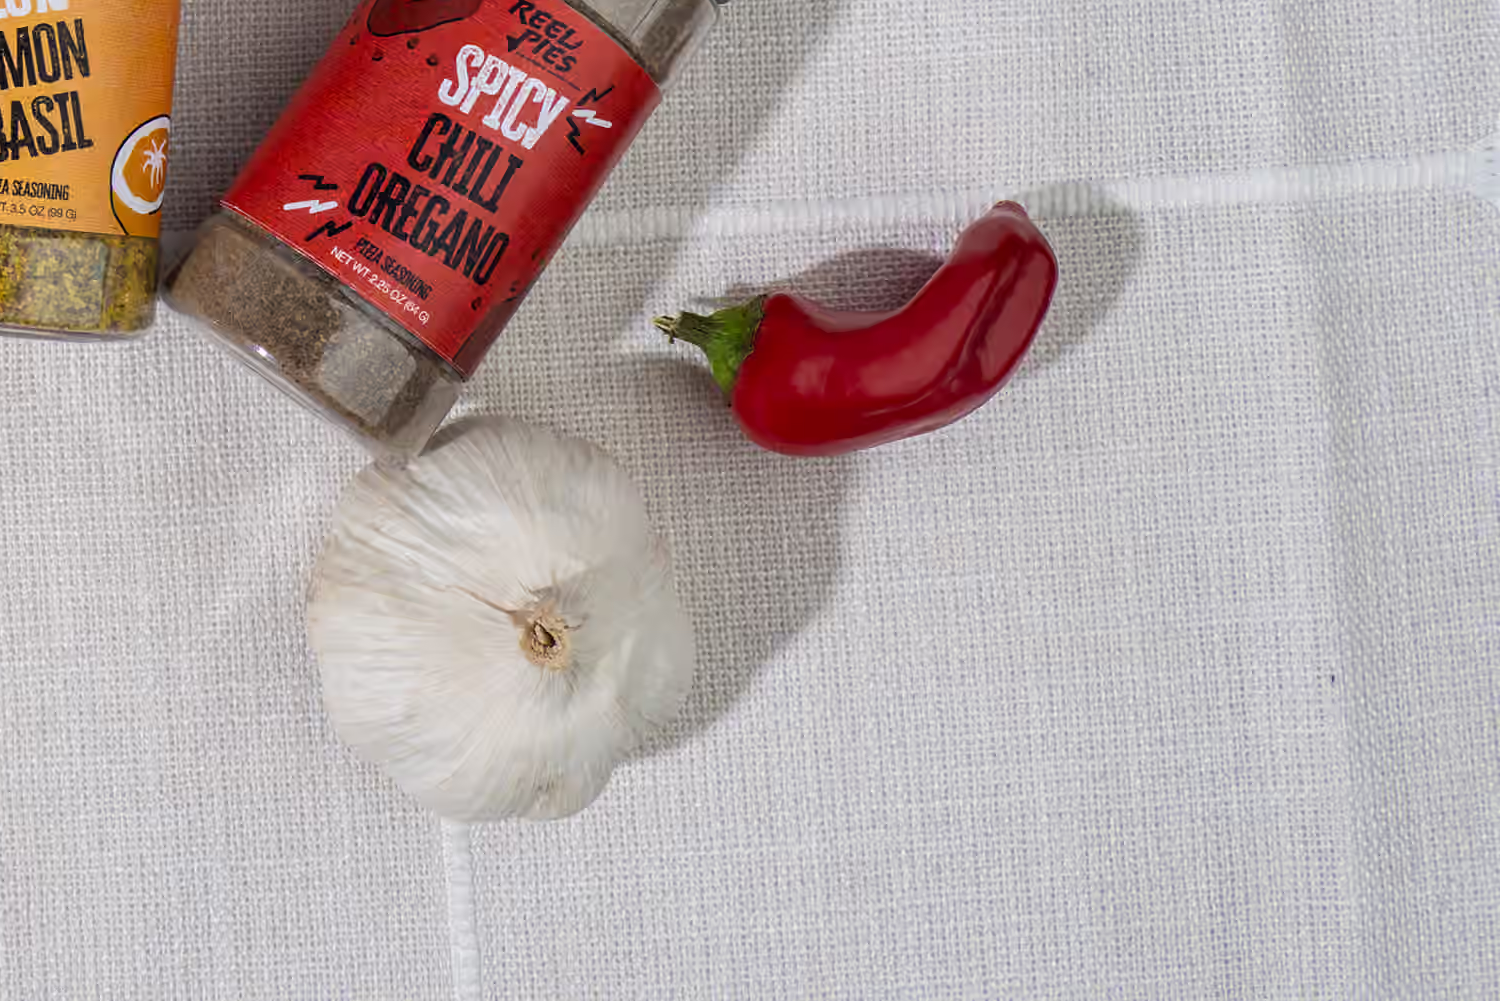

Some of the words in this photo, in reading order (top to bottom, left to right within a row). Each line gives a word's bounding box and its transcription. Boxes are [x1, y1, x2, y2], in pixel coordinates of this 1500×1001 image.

[506, 28, 578, 73] PIES
[438, 44, 571, 150] SPICY
[11, 179, 70, 201] SEASONING
[407, 112, 523, 214] CHILI
[28, 204, 45, 217] OZ
[348, 162, 510, 286] OREGANO
[330, 245, 355, 265] NET
[389, 289, 408, 305] OZ
[356, 237, 385, 265] PIZZA
[380, 255, 434, 301] SEASONING
